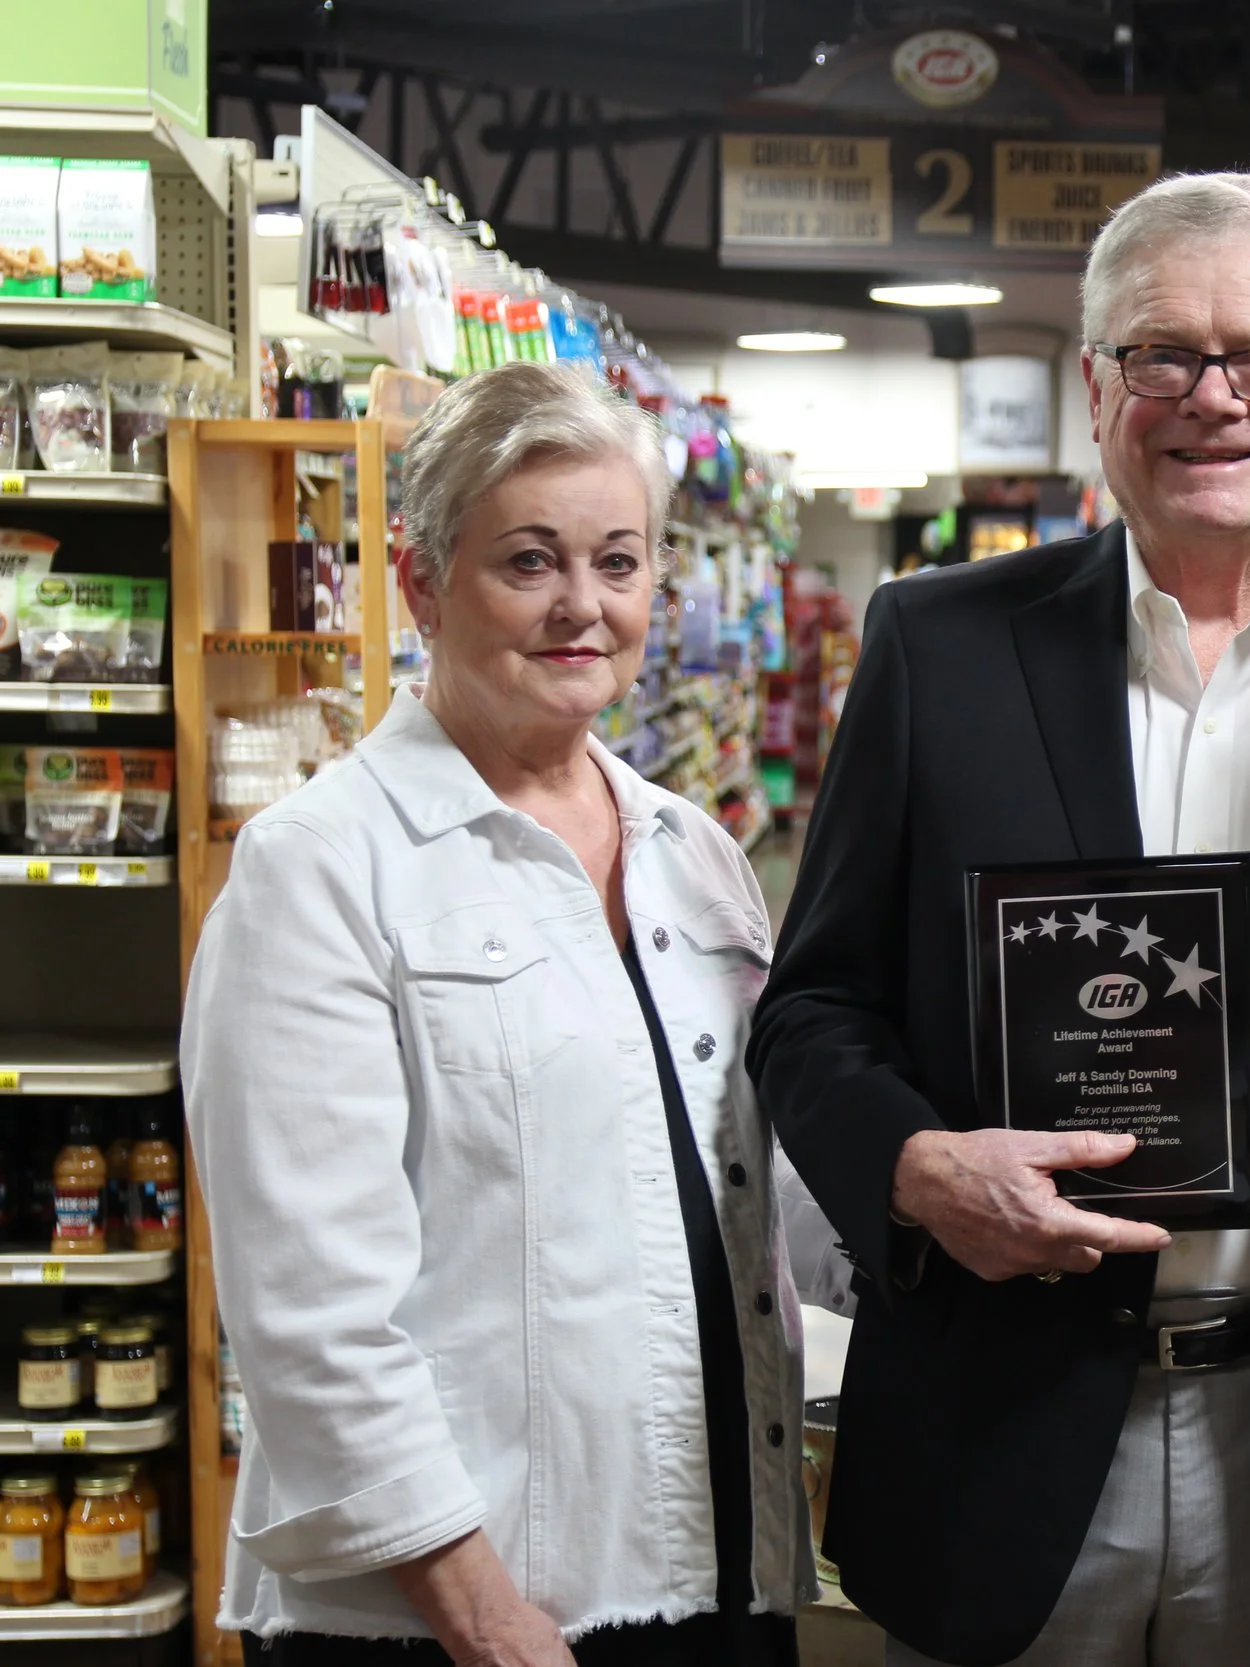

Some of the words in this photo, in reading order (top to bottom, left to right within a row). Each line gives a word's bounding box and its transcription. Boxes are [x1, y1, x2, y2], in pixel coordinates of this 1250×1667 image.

[1007, 147, 1077, 174] SPORTS
[1082, 150, 1149, 176] DRINKS
[823, 176, 872, 201] FRUIT
[914, 149, 973, 235] 2
[1053, 183, 1102, 209] JUICE
[213, 638, 295, 655] CALORIE
[301, 639, 347, 655] FREE
[1087, 983, 1141, 1009] IGA
[1053, 1030, 1098, 1042] Lifetime
[1101, 1026, 1174, 1040] Achievement
[1097, 1042, 1134, 1054] Award
[1055, 1071, 1077, 1083] Jeff
[1079, 1071, 1088, 1082] &
[1090, 1070, 1126, 1082] Sandy
[1128, 1068, 1178, 1080] Downing
[1081, 1084, 1130, 1096] Foothills
[1132, 1083, 1153, 1094] IGA
[1074, 1106, 1090, 1115] For
[1091, 1106, 1110, 1116] your
[1112, 1103, 1162, 1113] unwavering
[1055, 1117, 1099, 1127] dedication
[1101, 1117, 1110, 1125] to
[1111, 1117, 1131, 1127] your
[1132, 1114, 1181, 1125] employees,
[1127, 1126, 1144, 1135] and
[1145, 1126, 1159, 1135] the
[1146, 1137, 1183, 1146] Alliance.
